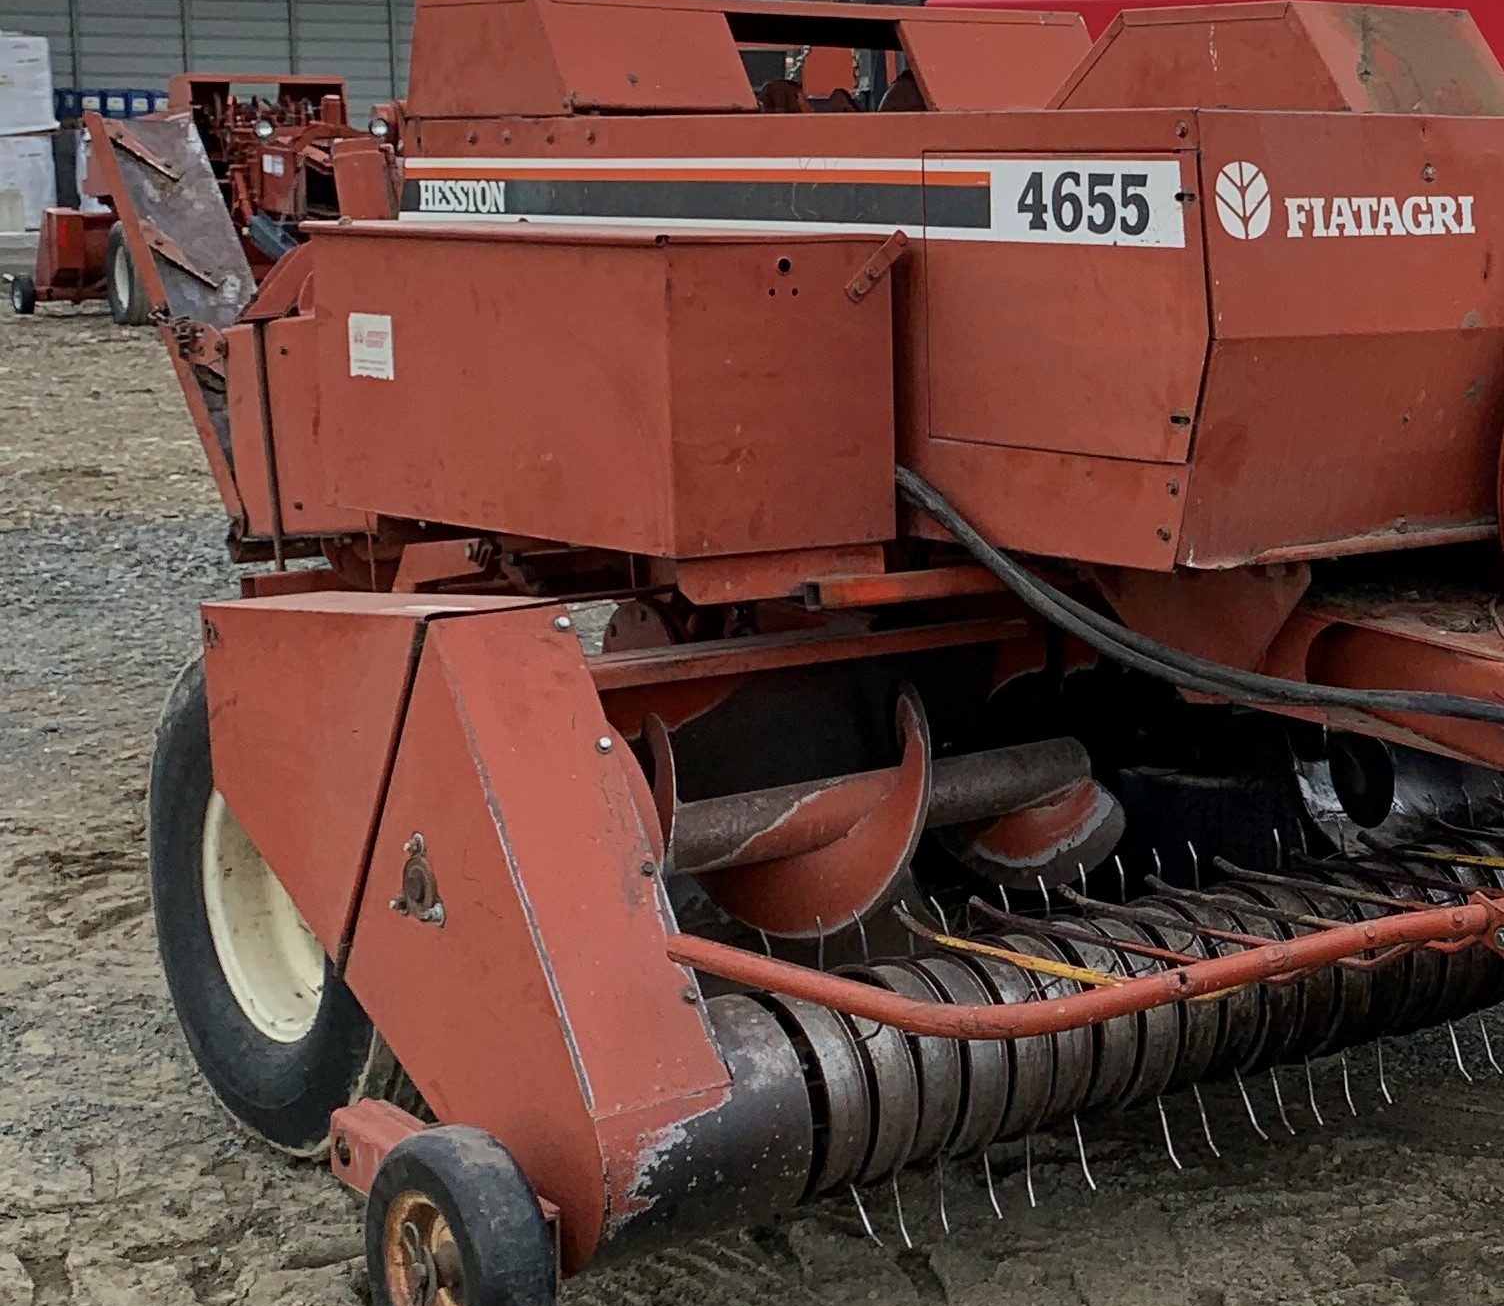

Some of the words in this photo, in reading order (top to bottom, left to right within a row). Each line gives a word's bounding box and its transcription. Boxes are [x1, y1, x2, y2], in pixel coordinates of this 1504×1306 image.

[418, 179, 506, 213] HESSTON
[1016, 170, 1151, 236] 4655
[1283, 195, 1476, 238] FIATAGRI
